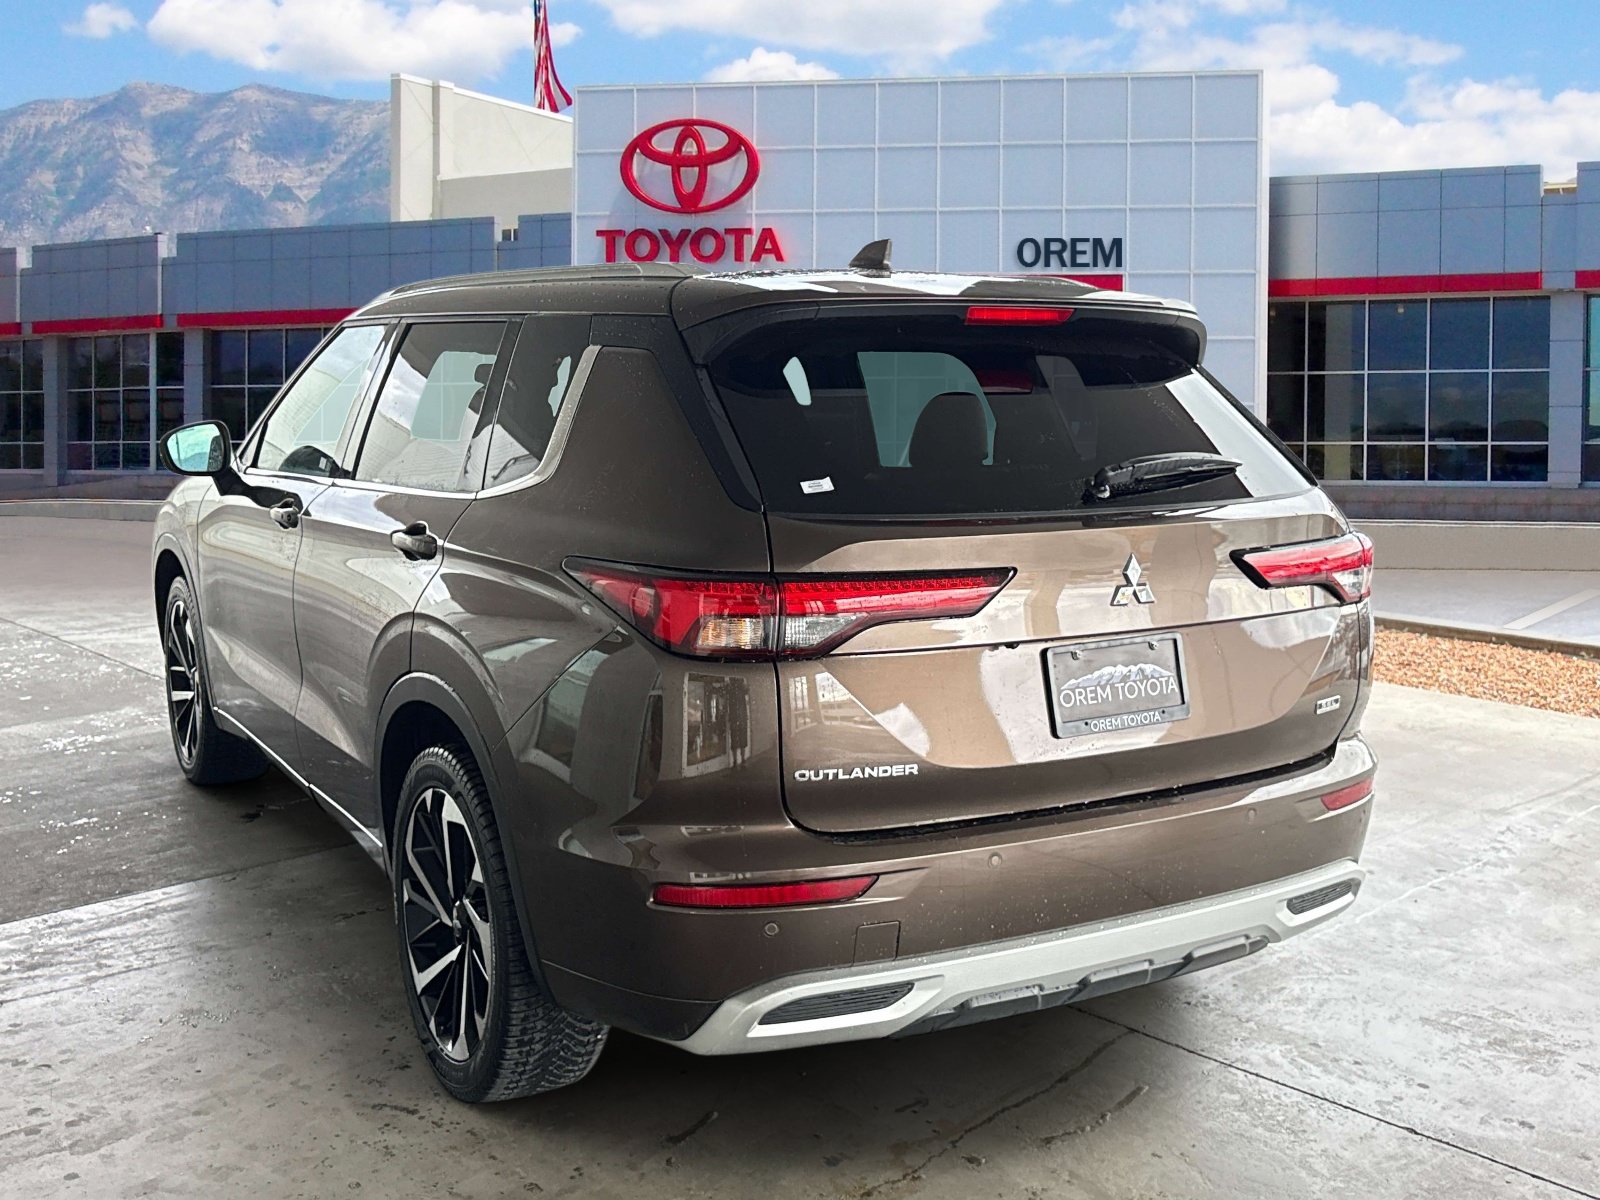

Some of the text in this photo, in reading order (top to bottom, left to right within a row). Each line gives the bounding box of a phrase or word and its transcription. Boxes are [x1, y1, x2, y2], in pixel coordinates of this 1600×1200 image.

[596, 227, 784, 263] TOYOTA
[1017, 237, 1123, 268] OREM
[1060, 676, 1179, 707] OREM TOYOTA
[1090, 711, 1161, 732] OREM TOYOTA
[794, 763, 919, 782] OUTLANDER
